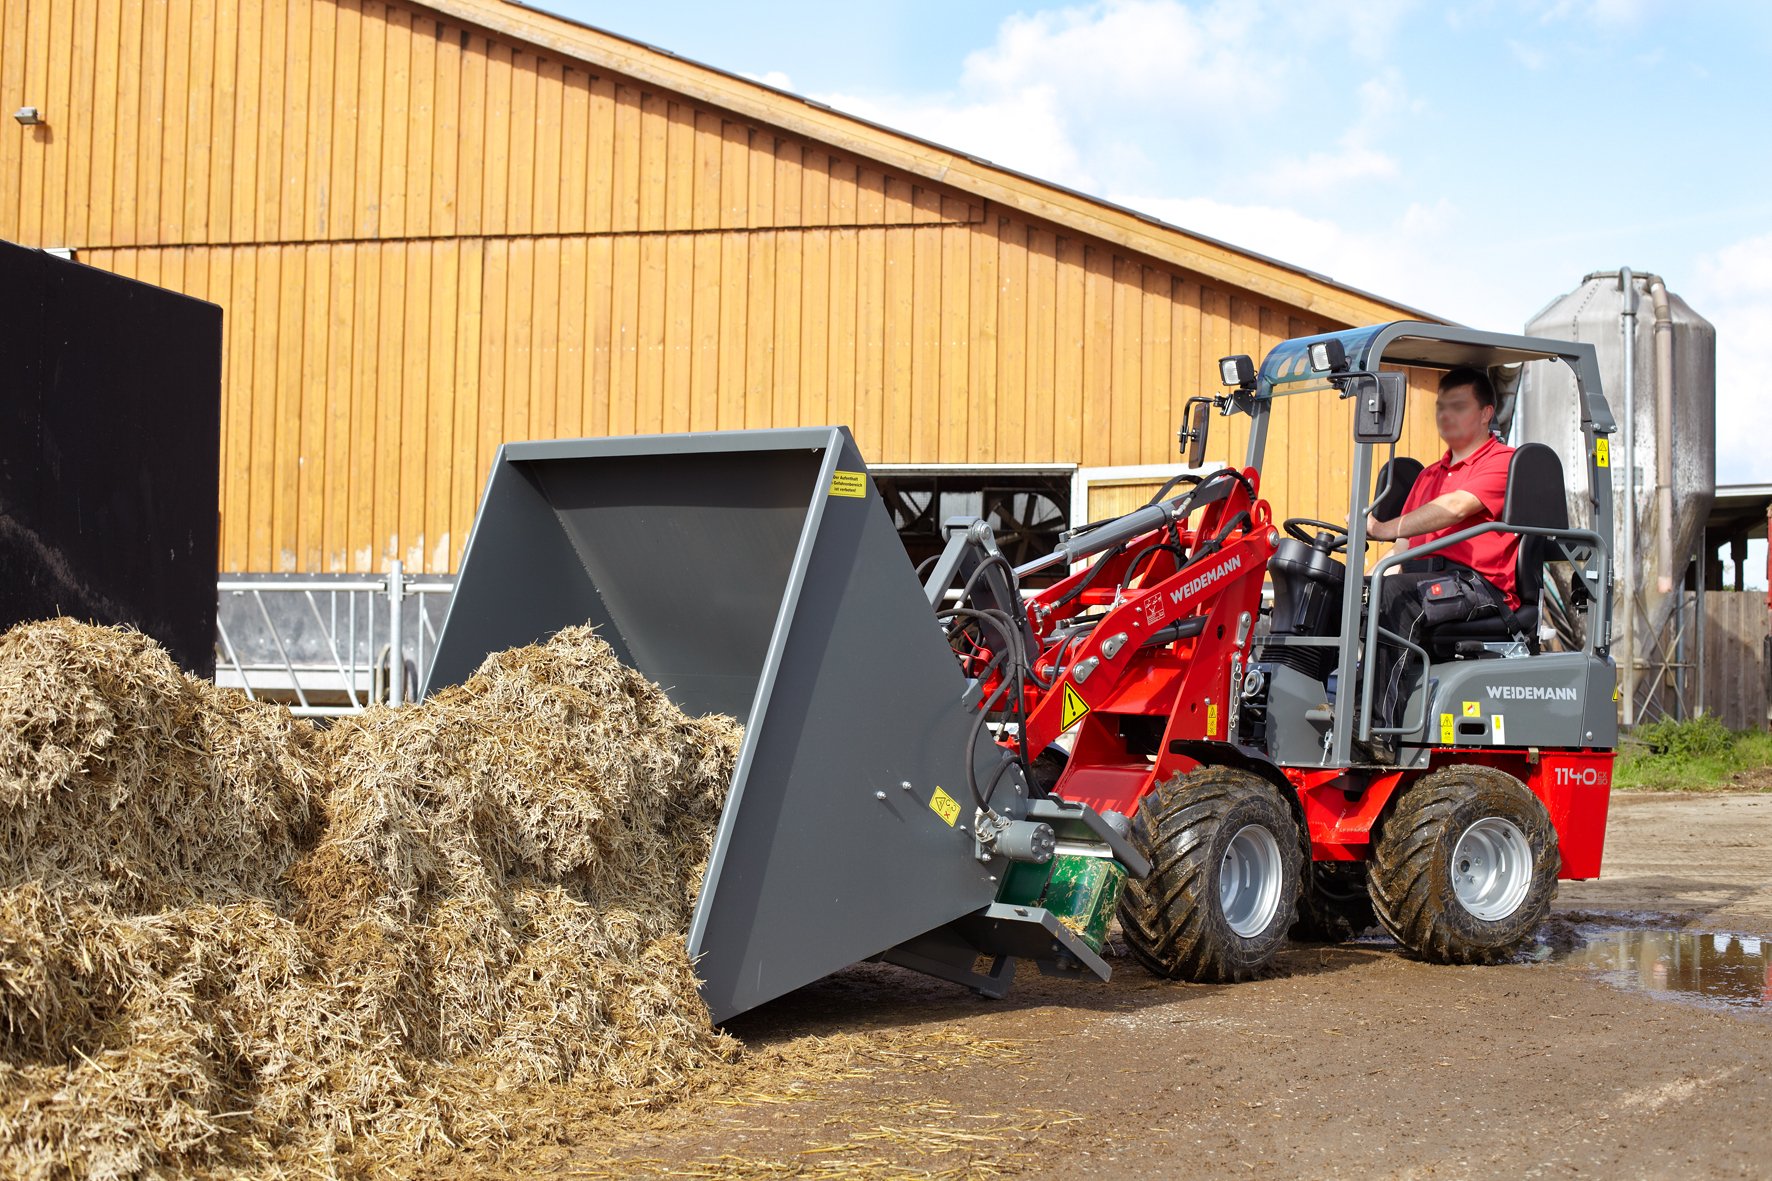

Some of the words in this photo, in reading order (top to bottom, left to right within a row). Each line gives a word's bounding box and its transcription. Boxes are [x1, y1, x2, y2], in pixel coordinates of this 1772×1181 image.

[1170, 554, 1241, 604] WEIDEMANN
[1486, 686, 1576, 700] WEIDEMANN
[1554, 768, 1596, 785] 1140
